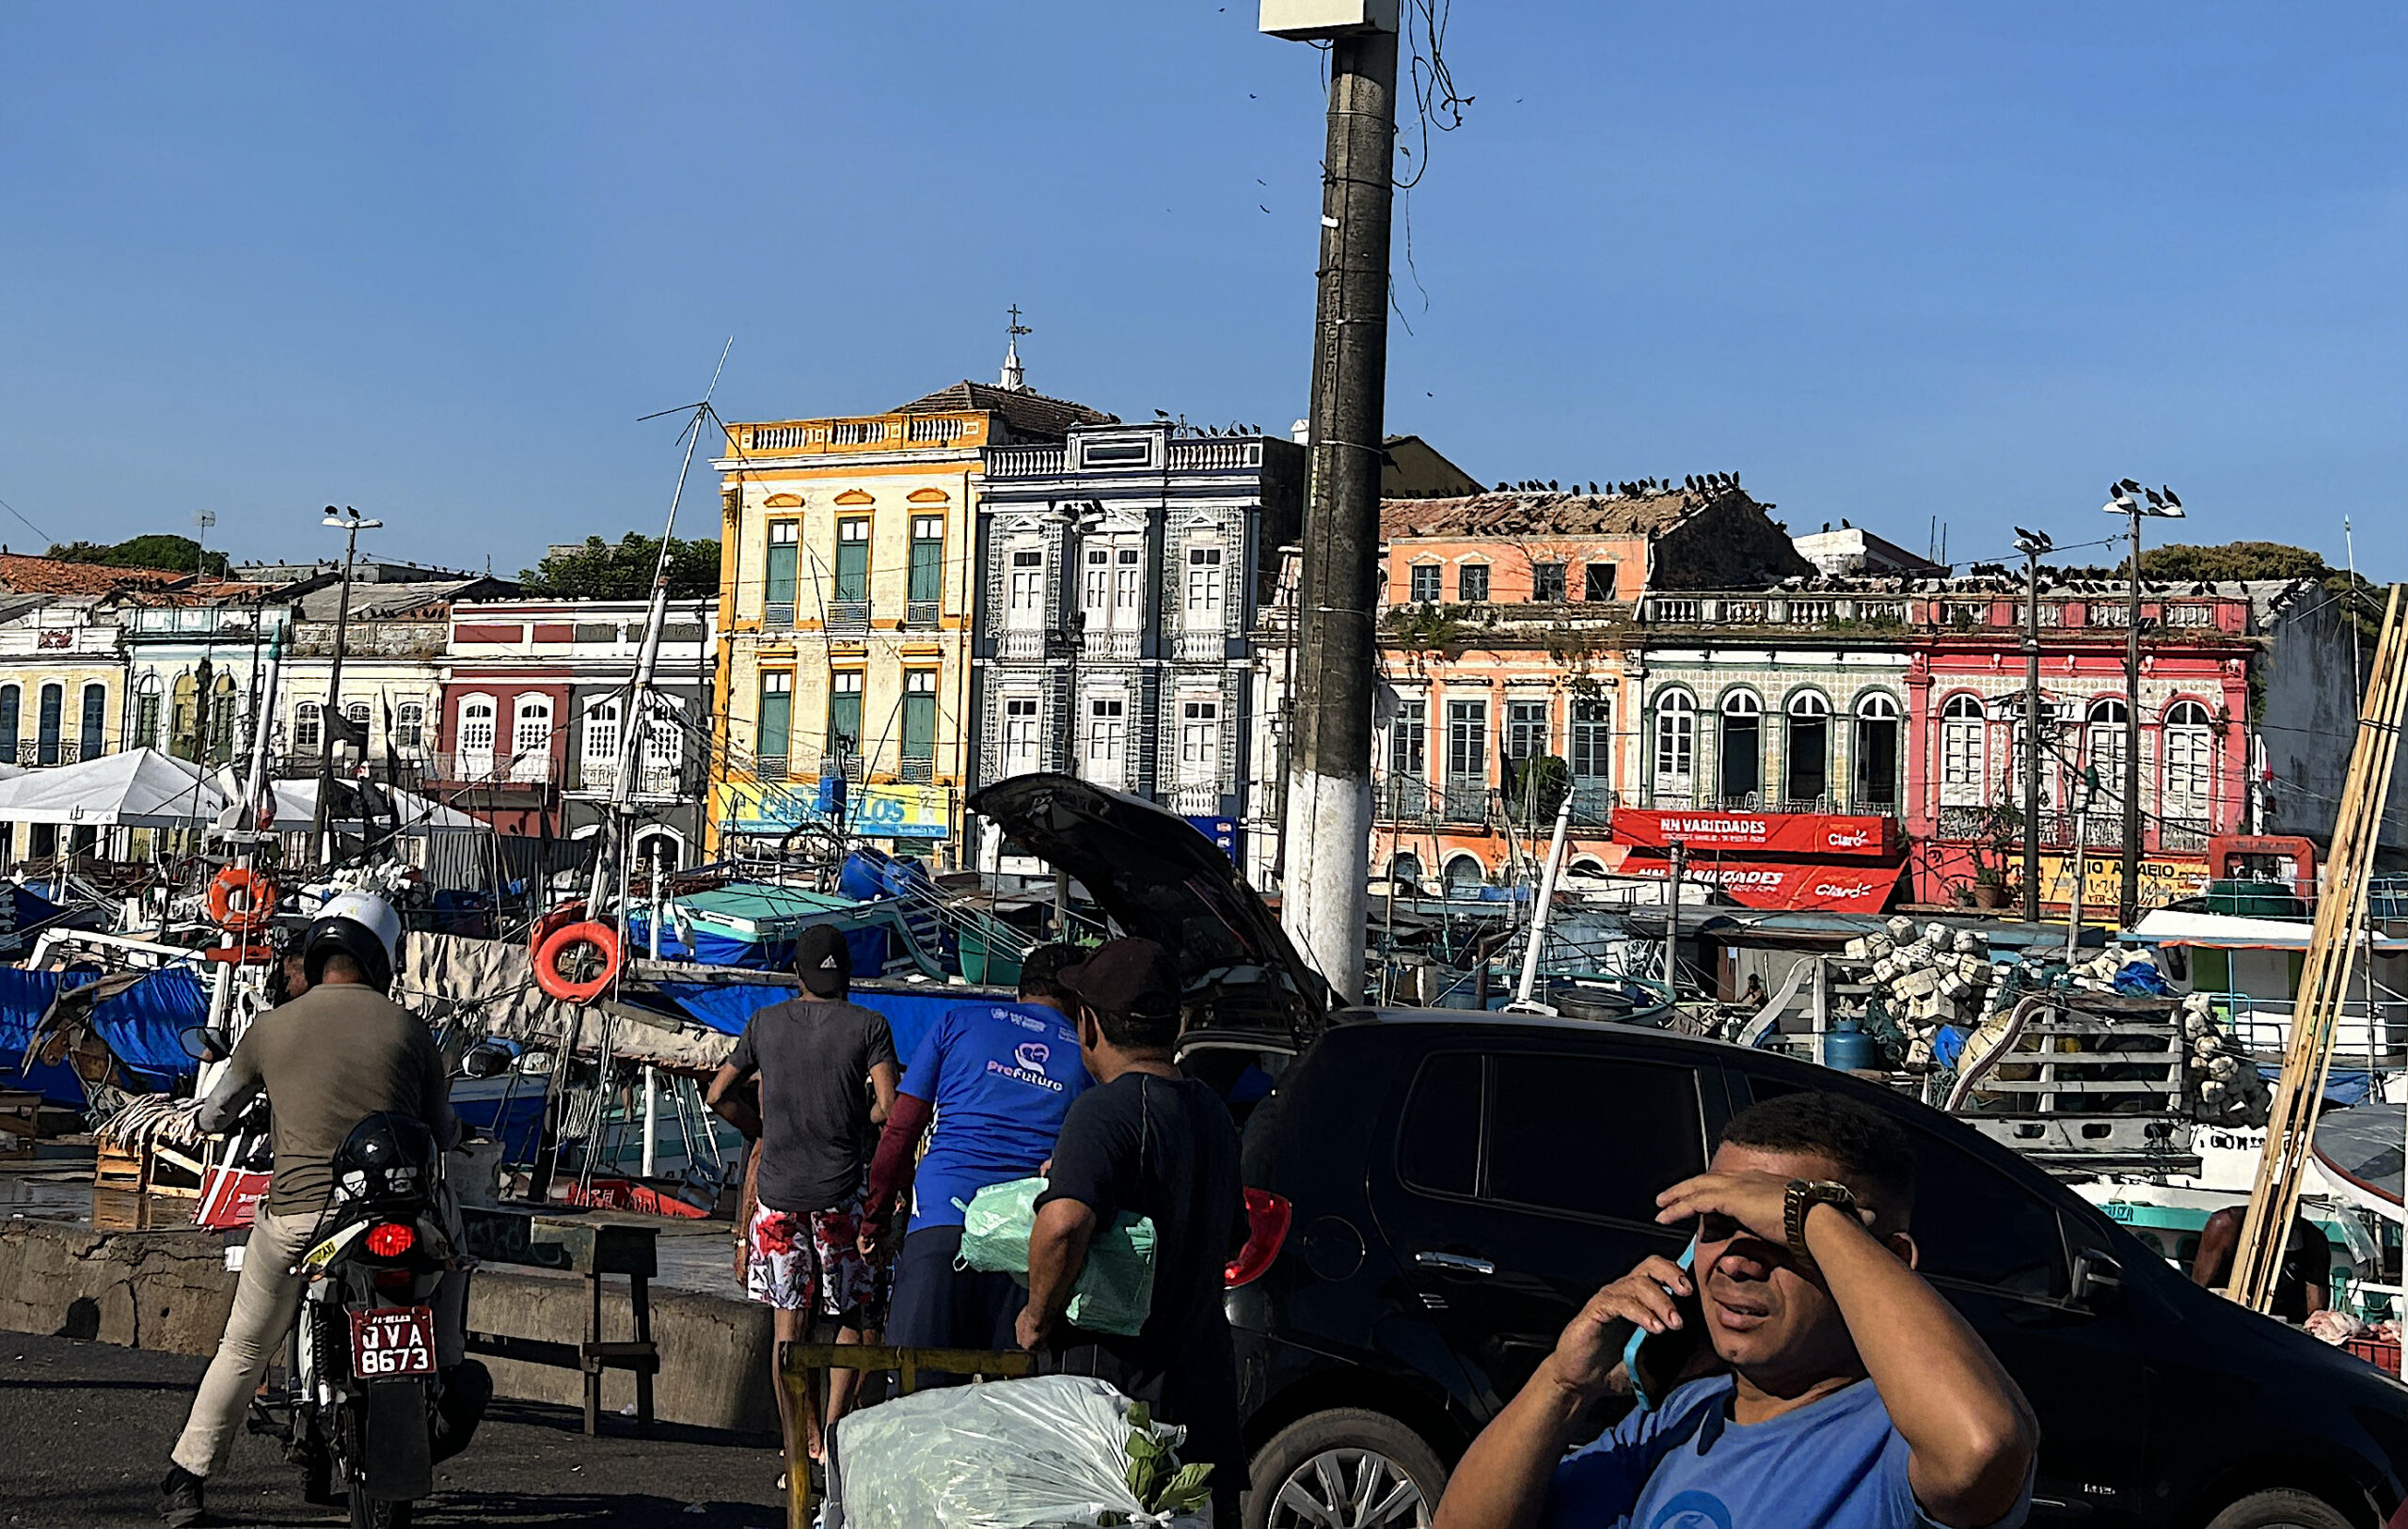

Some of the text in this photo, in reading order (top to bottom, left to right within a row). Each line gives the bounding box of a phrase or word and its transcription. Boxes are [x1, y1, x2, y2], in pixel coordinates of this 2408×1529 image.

[1682, 818, 1766, 834] VARIEDADES
[1828, 831, 1863, 847] Claro
[1681, 869, 1784, 885] ARIEDADES
[1814, 883, 1862, 900] Claro
[362, 1324, 423, 1349] JVA
[361, 1348, 429, 1374] 8673
